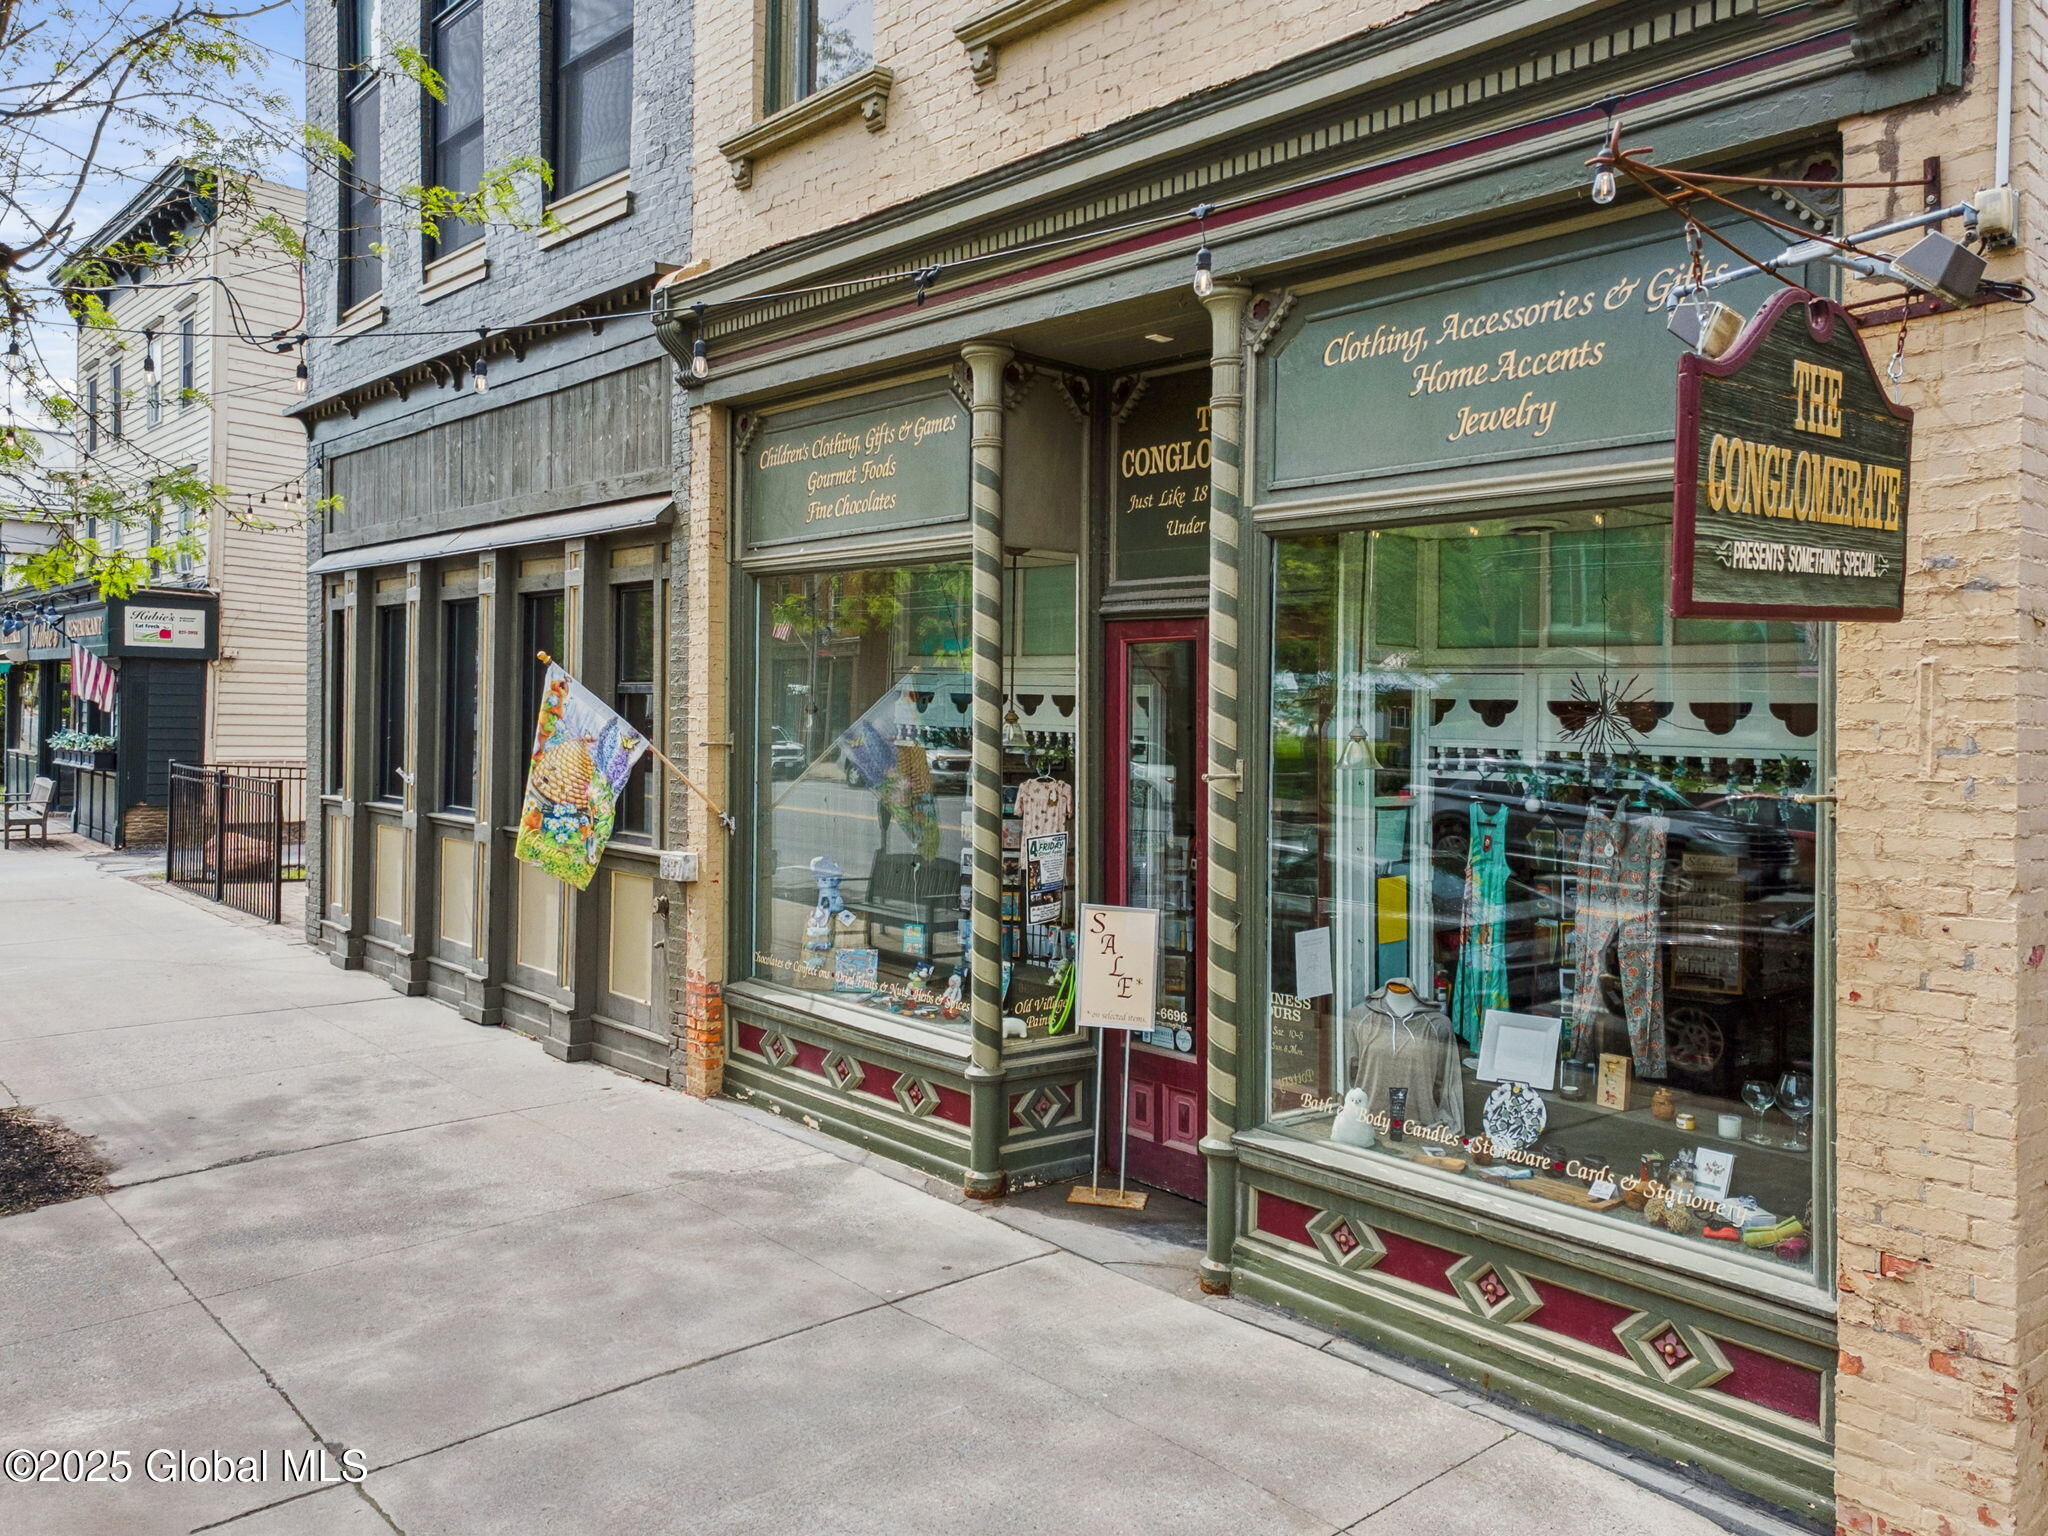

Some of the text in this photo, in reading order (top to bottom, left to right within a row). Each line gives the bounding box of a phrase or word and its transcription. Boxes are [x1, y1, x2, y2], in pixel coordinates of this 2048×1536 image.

[1323, 323, 1428, 367] Clothing,
[1436, 289, 1594, 345] Accessories
[1604, 277, 1641, 310] &
[1409, 340, 1606, 397] Home Accents
[1447, 391, 1557, 442] Jewelry
[1793, 358, 1843, 438] THE
[759, 414, 958, 470] Children's Clothing, Gifts & Games
[807, 454, 896, 496] Gourmet Foods
[1708, 433, 1902, 532] CONGLOMERATE
[805, 490, 896, 524] Fine Chocolates
[1127, 484, 1208, 513] Just Like 18
[1166, 516, 1206, 536] Under
[1733, 541, 1877, 577] PRESENTS SOMETHING SPECIAL
[130, 610, 175, 621] Hubie's
[1039, 842, 1064, 851] FRIDAY
[793, 961, 831, 979] Confectons
[880, 981, 888, 992] &
[945, 997, 971, 1014] Spices
[1014, 998, 1034, 1014] Old
[1271, 1006, 1301, 1022] URS
[1288, 1030, 1304, 1041] 10-5
[1301, 1093, 1333, 1114] Bath
[1355, 1107, 1390, 1135] Body
[1403, 1119, 1460, 1147] Candles
[1566, 1160, 1615, 1184] Cards
[1620, 1174, 1642, 1190] &
[1643, 1180, 1747, 1227] Stationery
